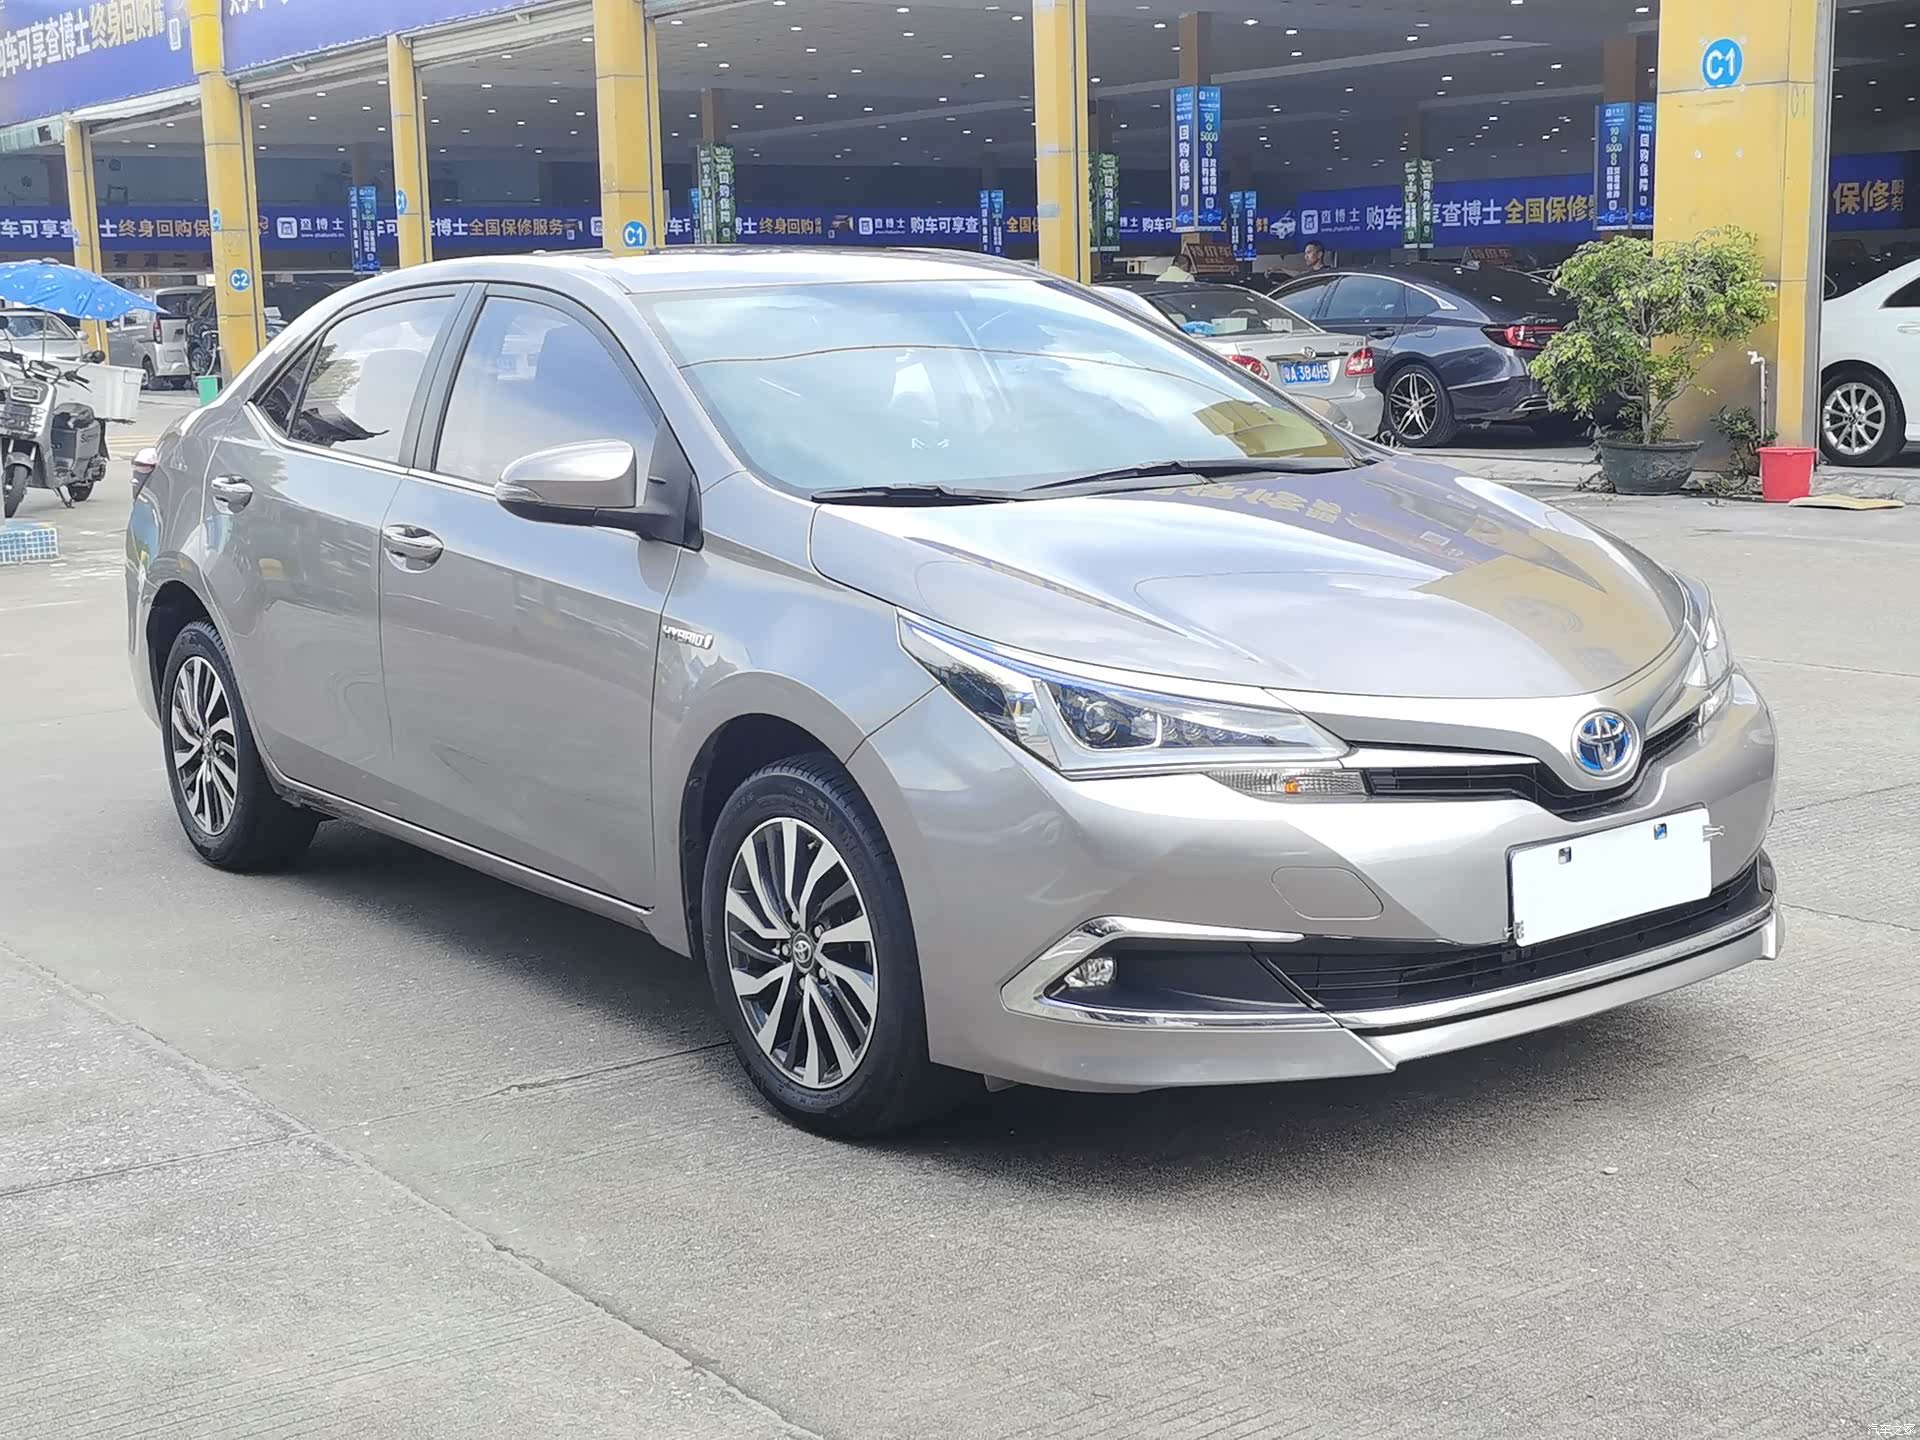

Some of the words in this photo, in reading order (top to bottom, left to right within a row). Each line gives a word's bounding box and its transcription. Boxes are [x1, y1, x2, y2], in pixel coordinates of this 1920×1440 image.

[1706, 48, 1735, 80] C1
[624, 227, 643, 244] C1
[231, 274, 249, 286] C2
